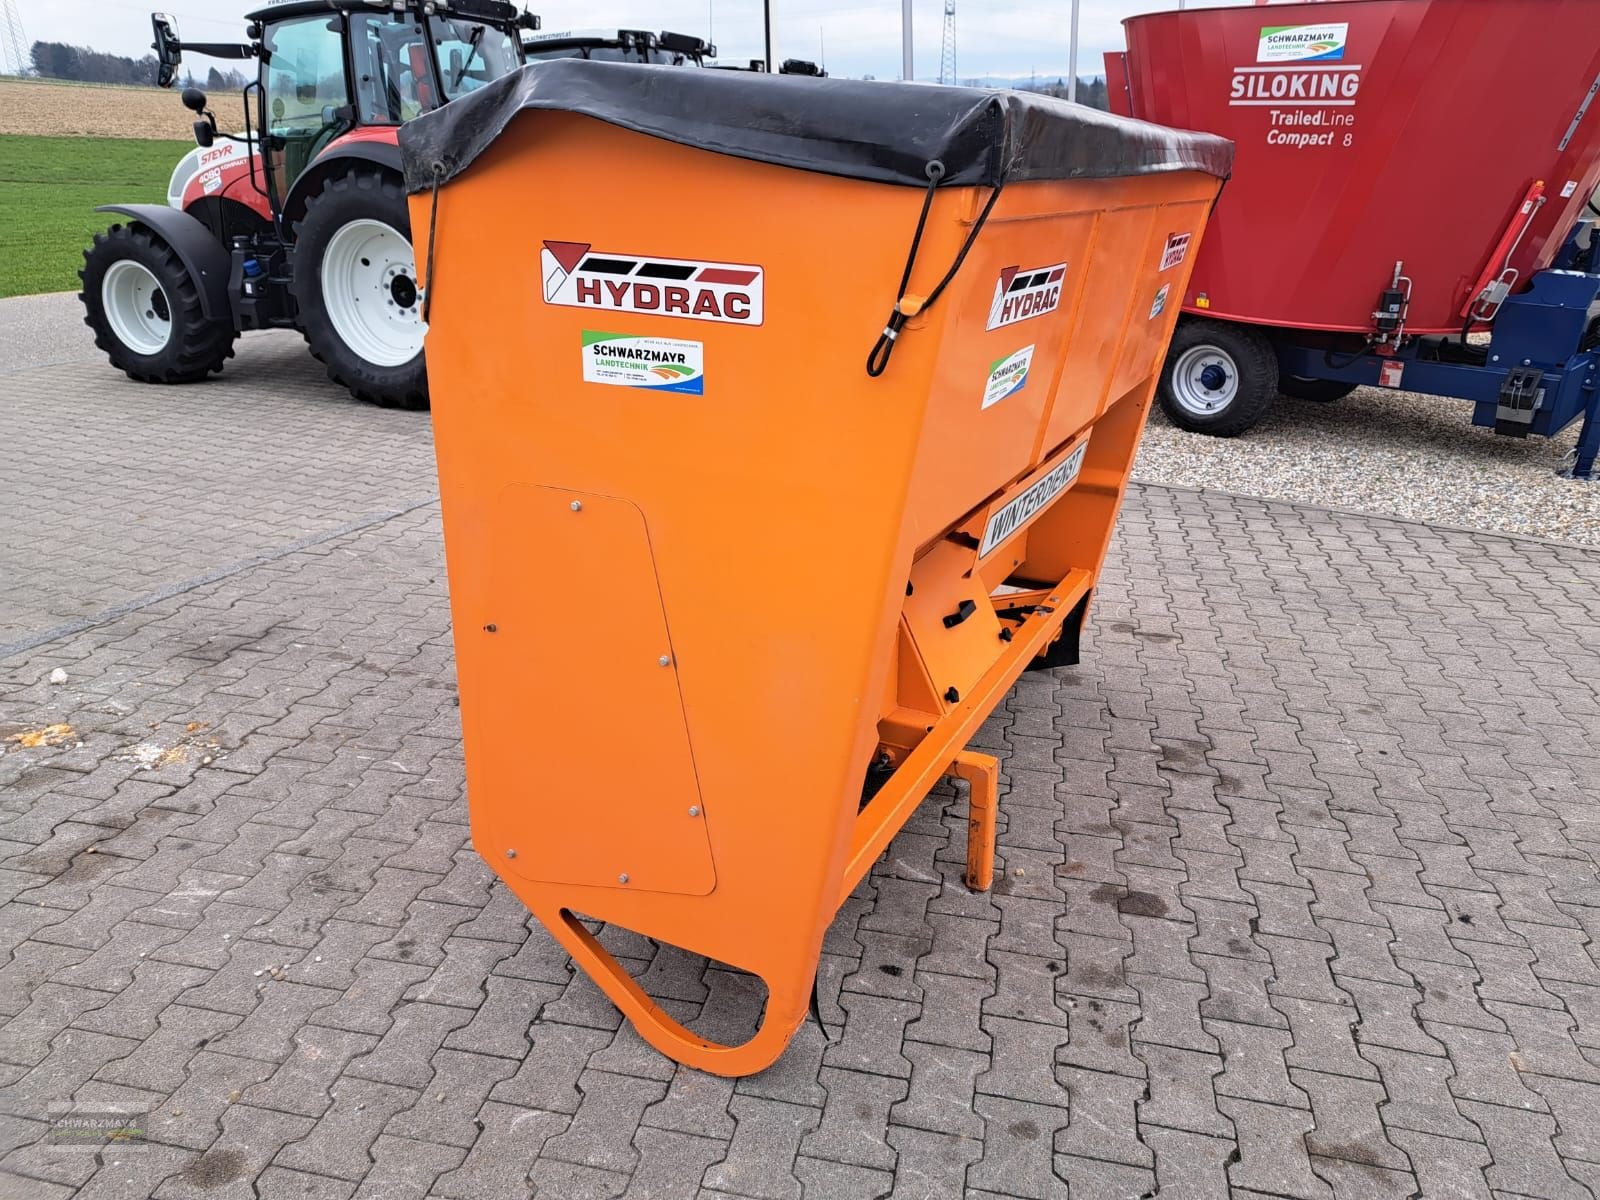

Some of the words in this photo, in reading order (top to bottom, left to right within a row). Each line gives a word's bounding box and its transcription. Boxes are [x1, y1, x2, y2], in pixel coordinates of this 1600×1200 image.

[1267, 32, 1335, 44] SCHWARZMAYR
[1230, 73, 1360, 98] SILOKING
[1269, 110, 1355, 126] TrailedLine
[1575, 111, 1583, 120] 2
[1266, 129, 1335, 149] Compact
[1343, 133, 1353, 147] 8
[1561, 138, 1568, 148] 1
[201, 145, 233, 166] STEYR
[199, 167, 221, 184] 4080
[576, 277, 751, 320] HYDRAC
[1000, 286, 1059, 323] HYDRAC
[593, 344, 686, 364] SCHWARZMAYR
[595, 358, 649, 371] LANDTECHNIK
[990, 448, 1083, 545] WINTERDIENST
